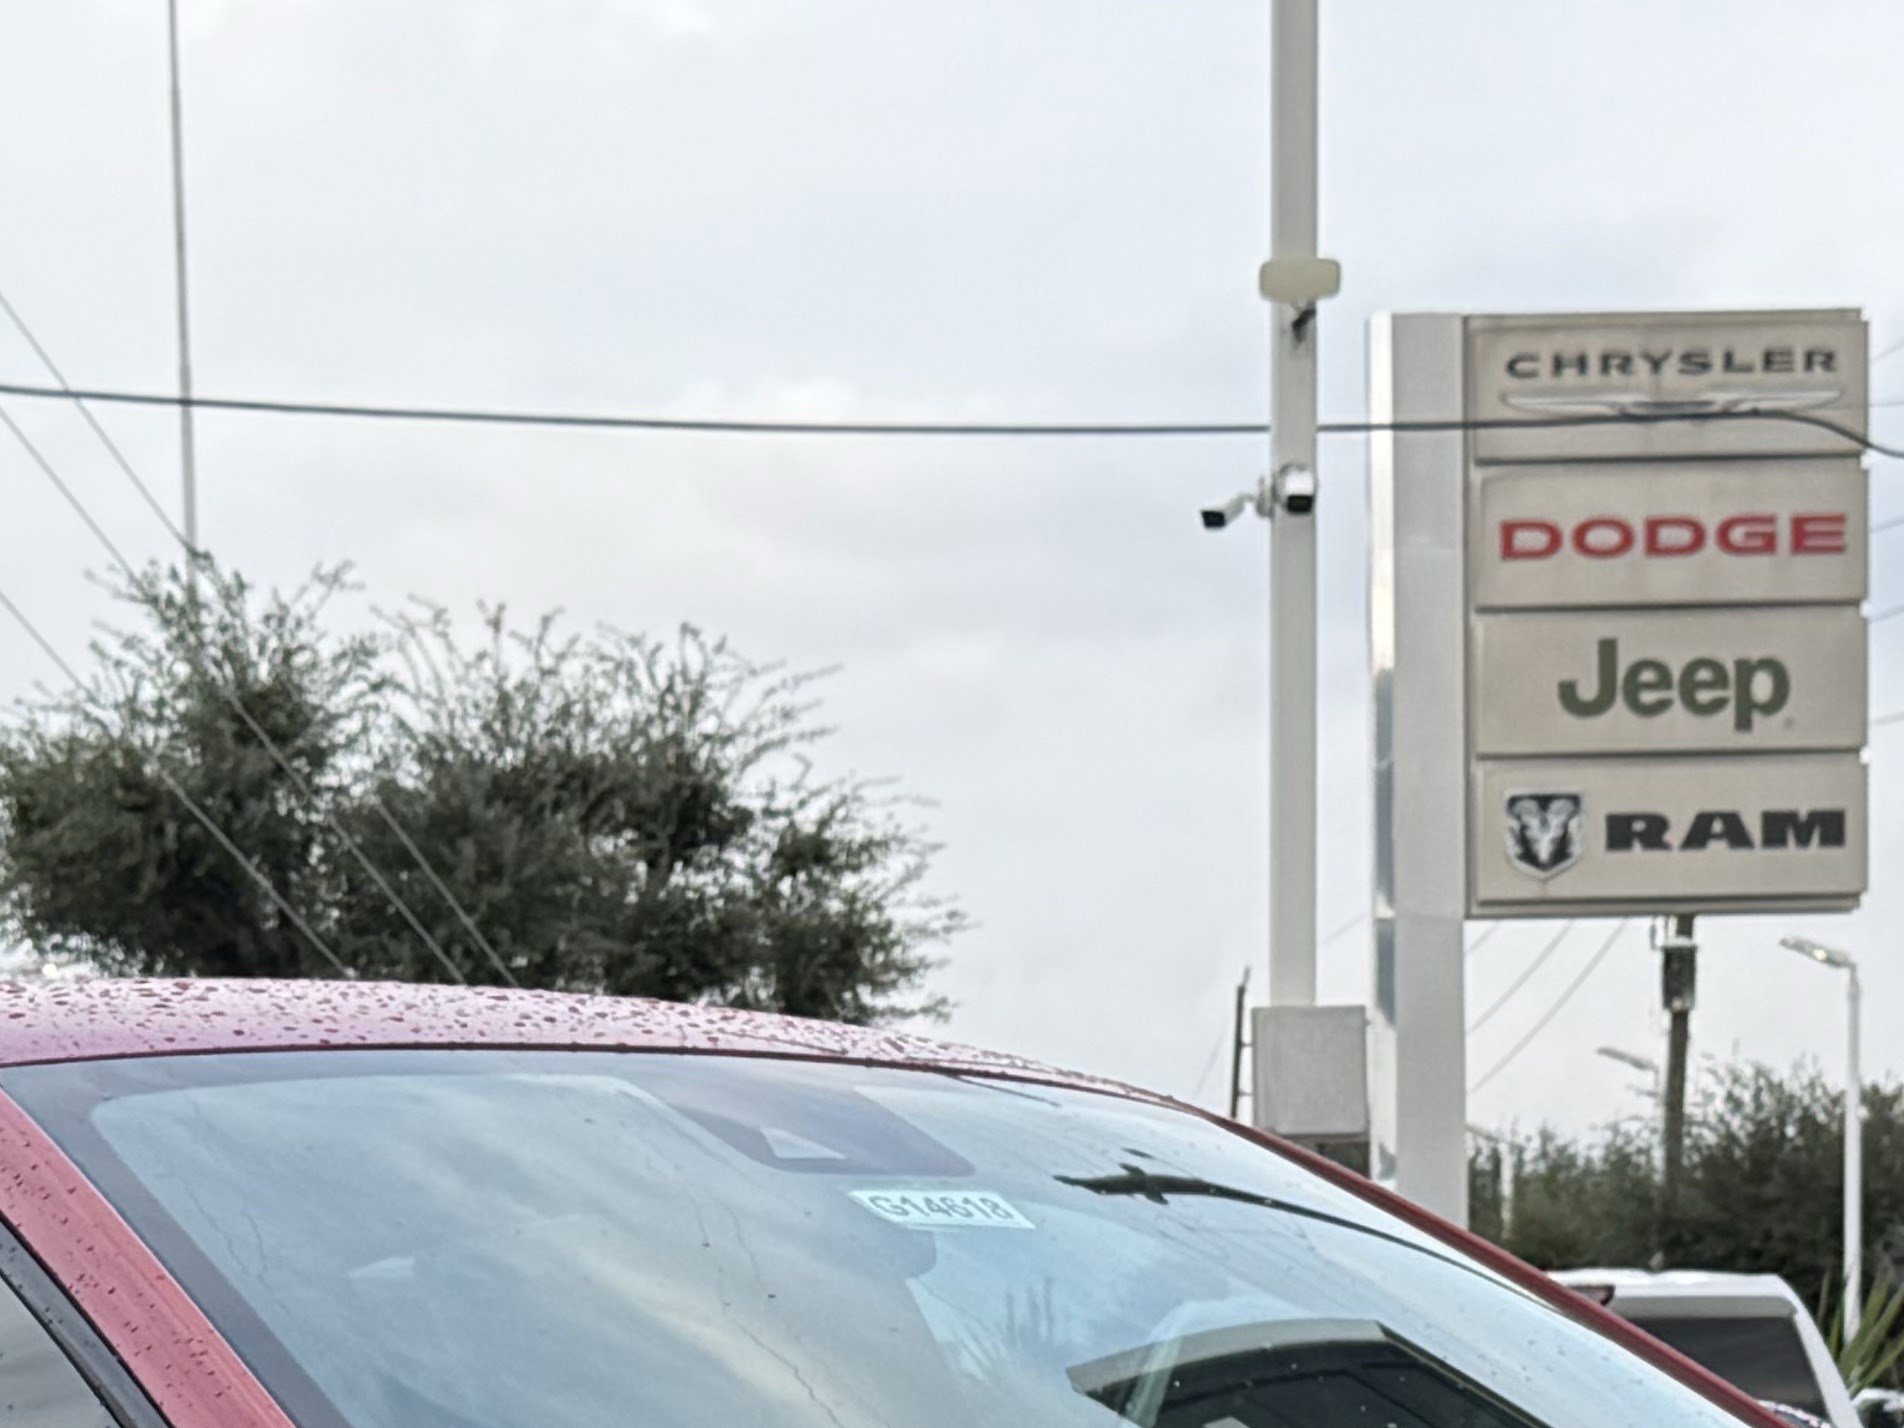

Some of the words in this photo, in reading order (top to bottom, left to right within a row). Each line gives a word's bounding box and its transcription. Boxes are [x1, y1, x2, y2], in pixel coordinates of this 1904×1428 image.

[1504, 349, 1838, 380] CHRYSLER
[1499, 513, 1847, 562] DODGE
[1557, 637, 1792, 732] Jeep
[1604, 809, 1846, 852] RAM
